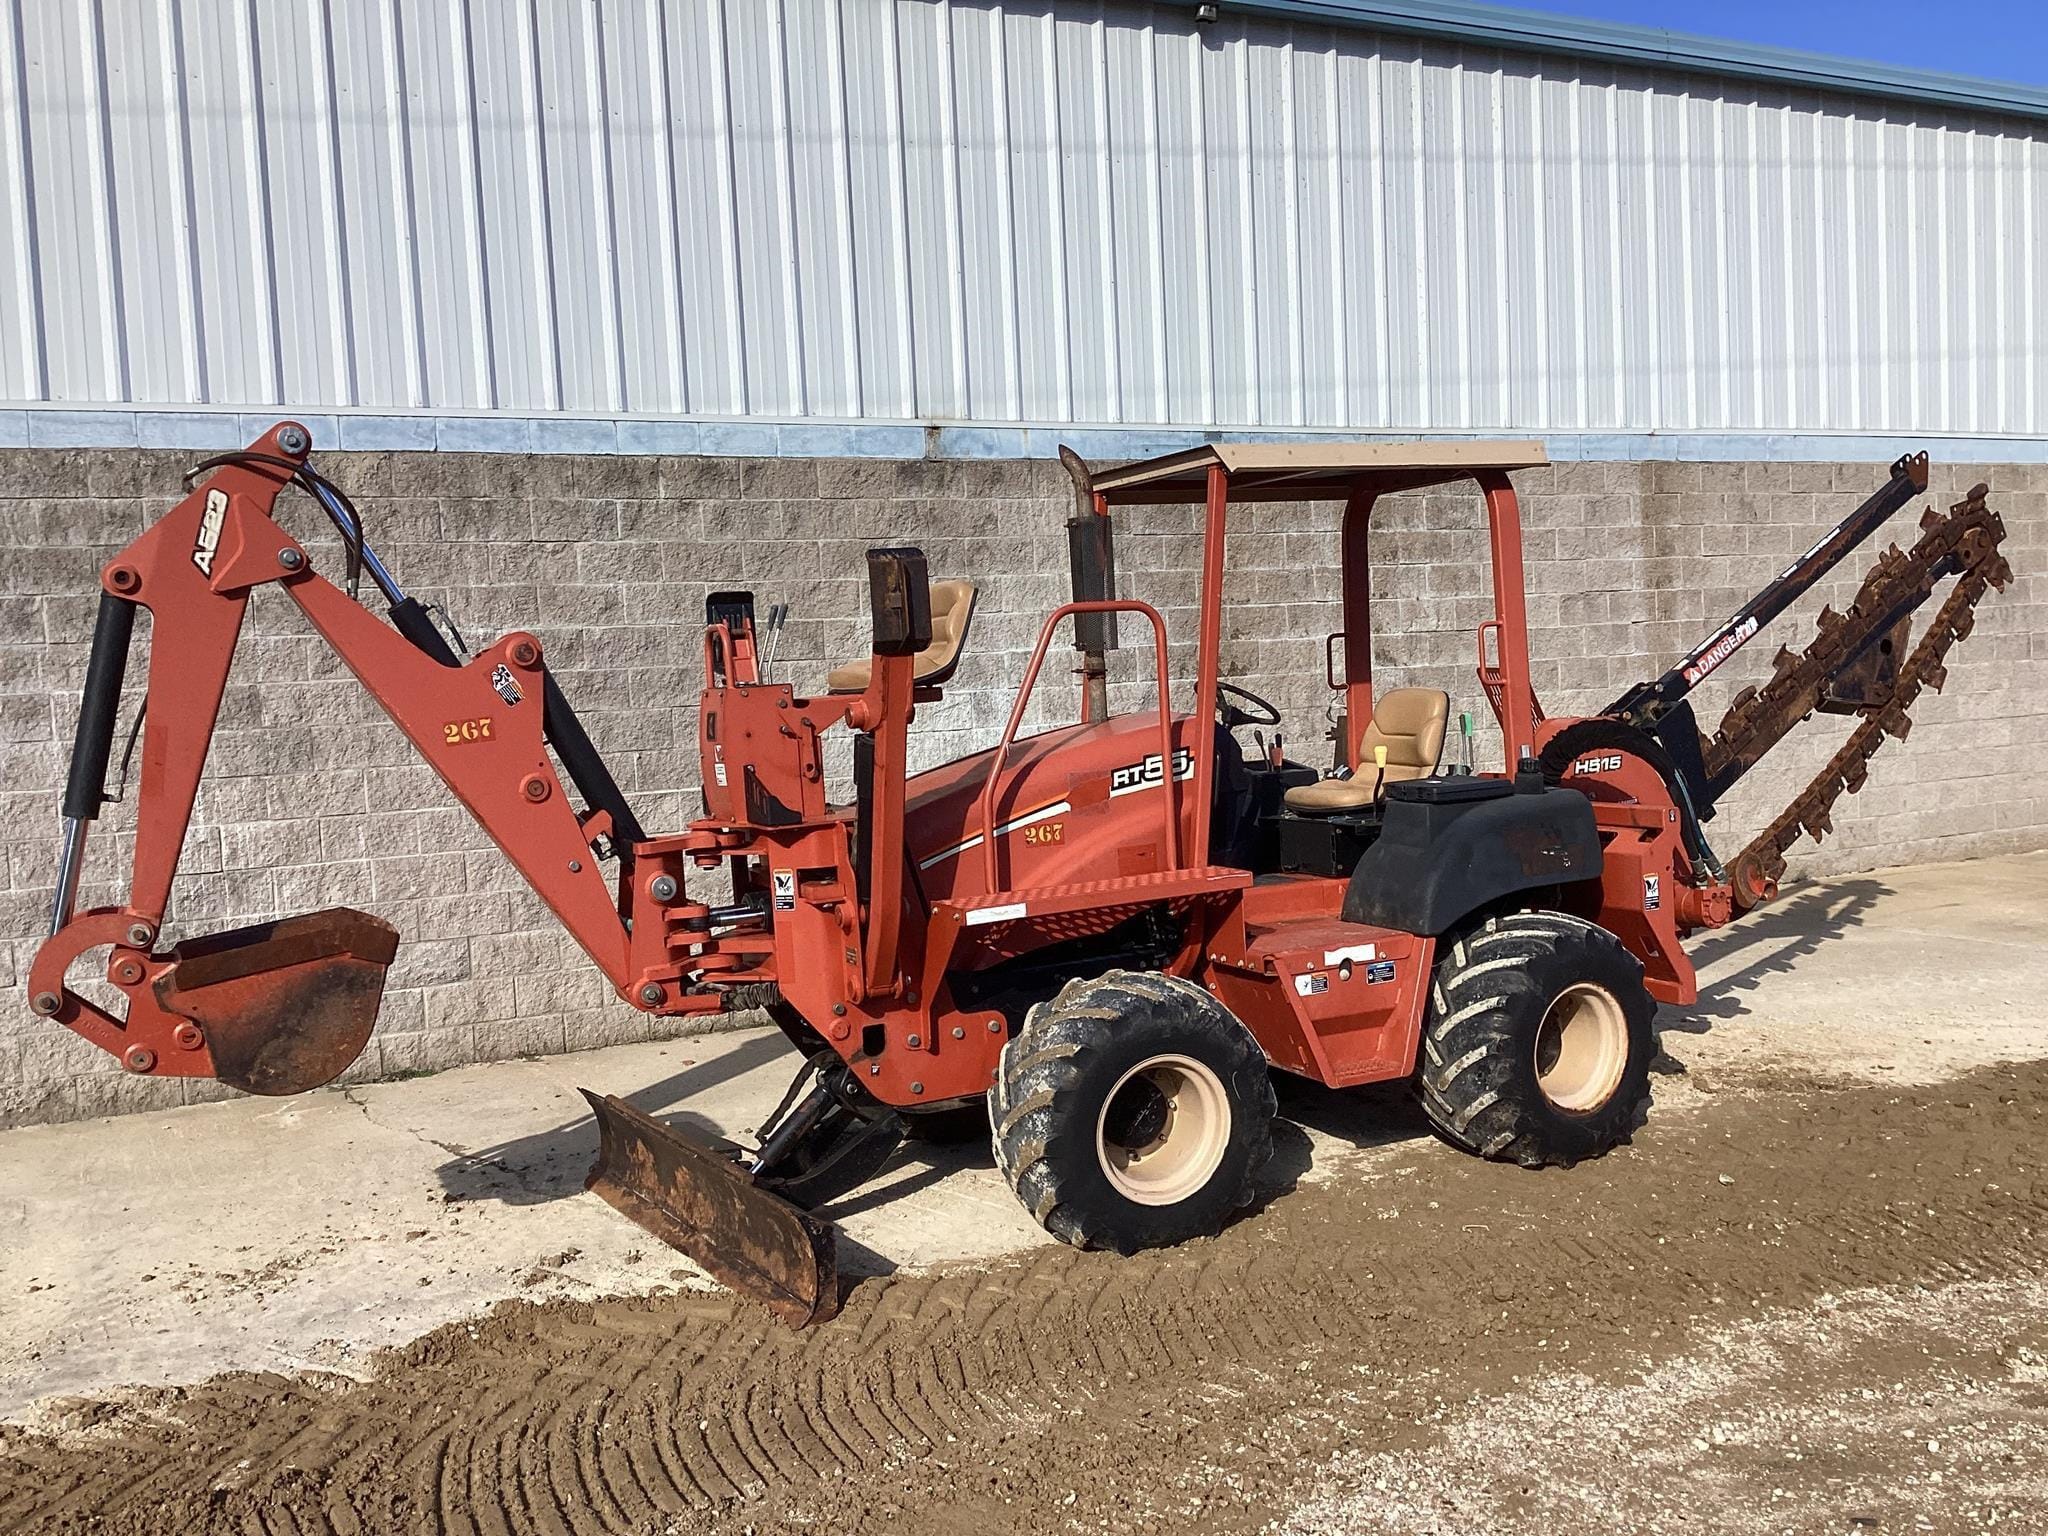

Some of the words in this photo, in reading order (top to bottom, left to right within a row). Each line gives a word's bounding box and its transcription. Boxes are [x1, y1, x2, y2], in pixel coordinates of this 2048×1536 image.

[443, 718, 491, 743] 267
[1574, 755, 1622, 775] H515
[1024, 823, 1063, 844] 267
